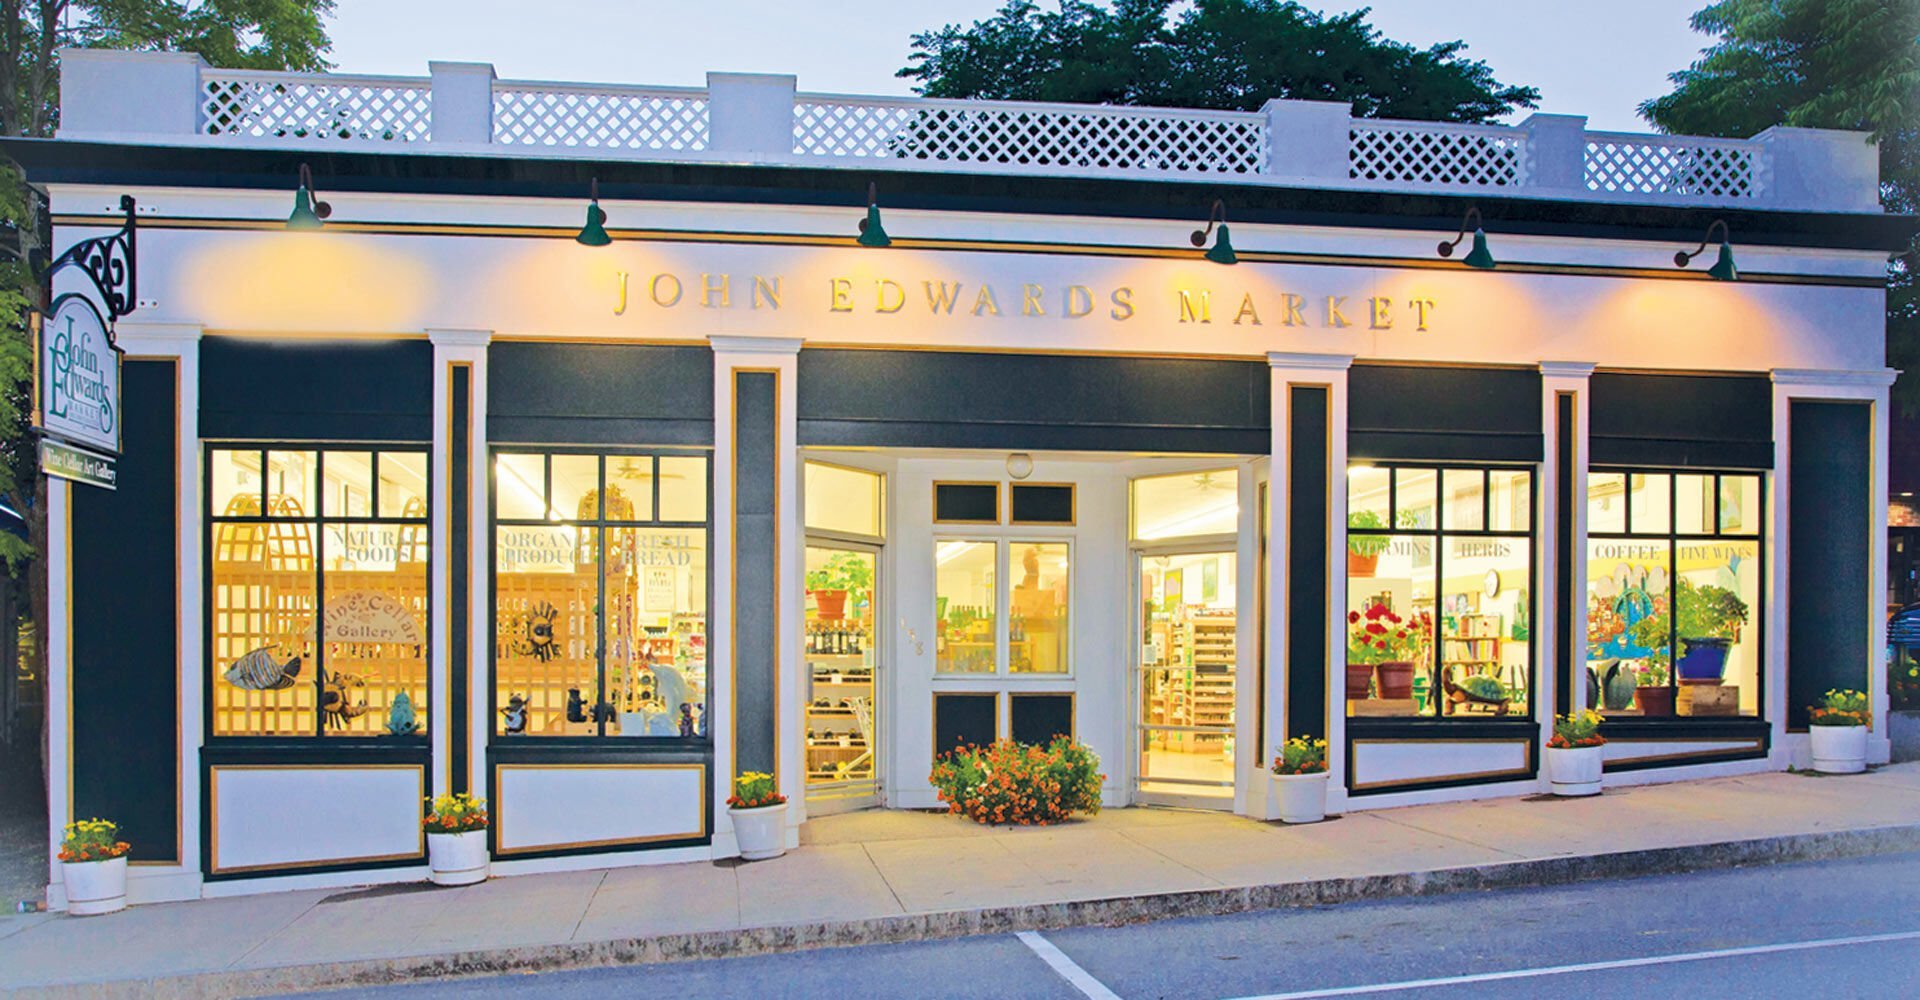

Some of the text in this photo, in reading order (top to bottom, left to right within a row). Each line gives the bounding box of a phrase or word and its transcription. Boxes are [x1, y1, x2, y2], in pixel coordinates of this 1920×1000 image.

[613, 271, 1436, 332] JOHN EDWARDS MARKET
[55, 315, 98, 374] John
[49, 345, 113, 434] Edwards
[84, 458, 94, 476] Art
[95, 462, 116, 485] Gallery
[621, 534, 690, 549] FRESH
[345, 547, 409, 562] FOODS
[621, 550, 691, 566] BREAD
[1461, 543, 1511, 558] HERBS
[1595, 544, 1660, 560] COFFEE
[1681, 545, 1753, 560] FINE WINES
[368, 595, 418, 642] Cellar
[336, 624, 396, 641] Gallery
